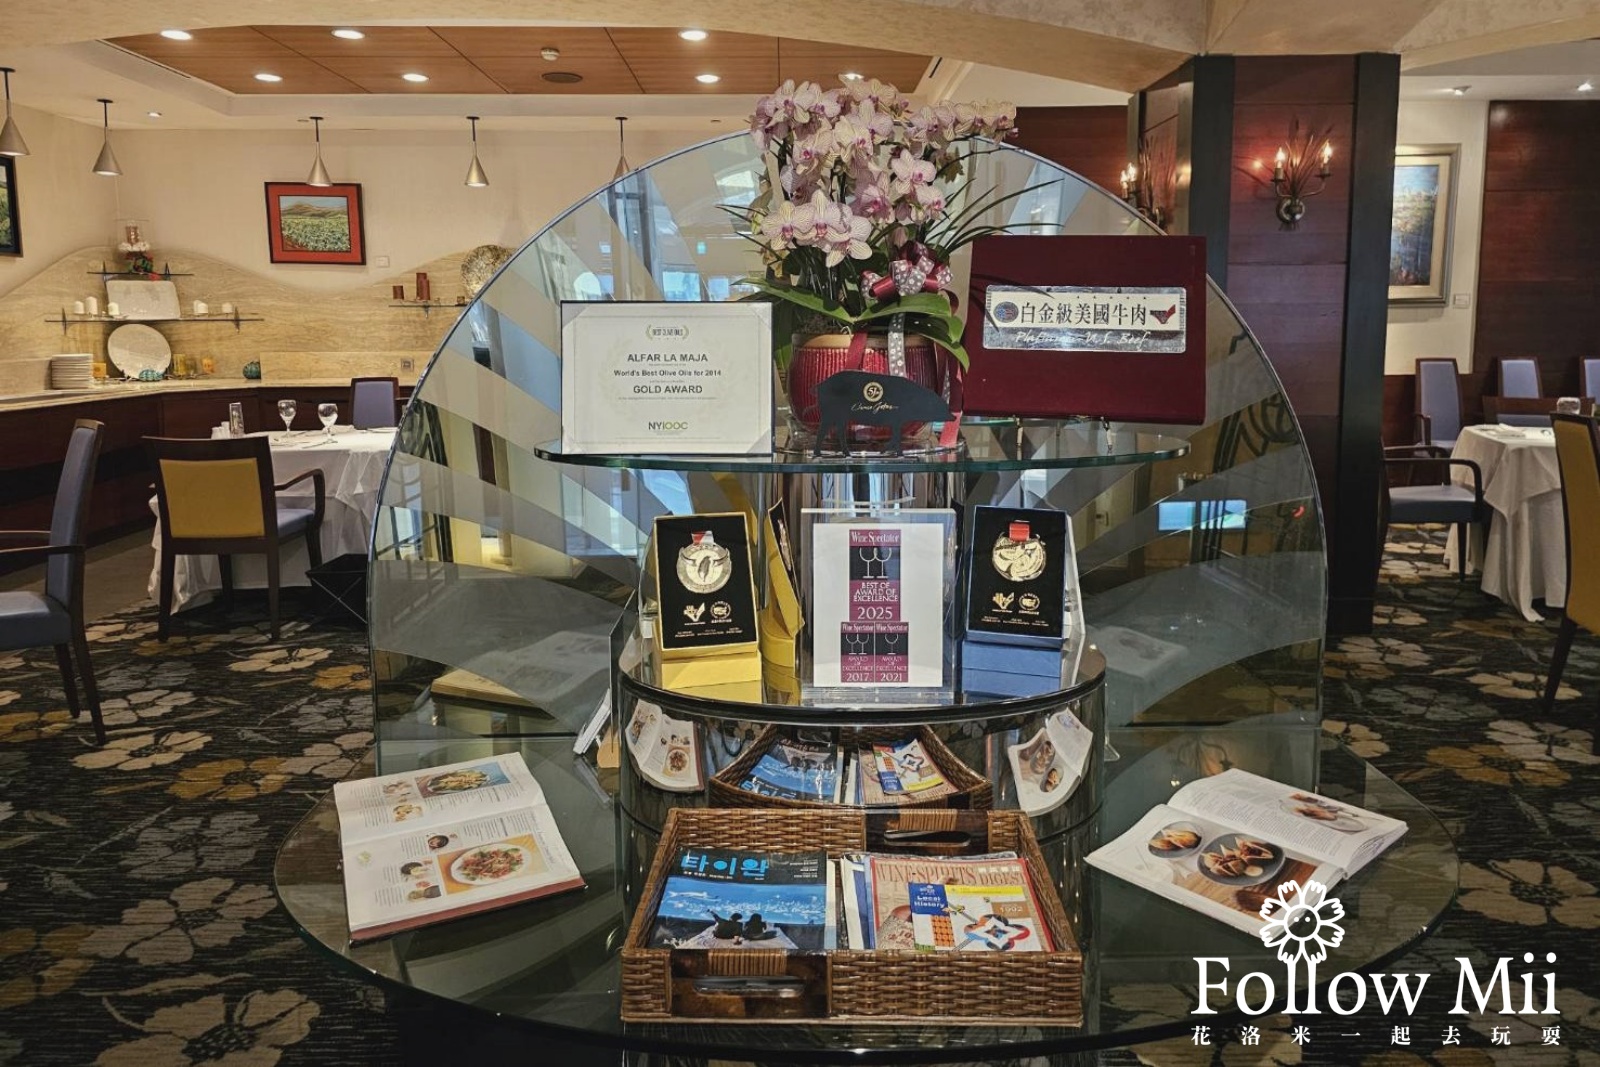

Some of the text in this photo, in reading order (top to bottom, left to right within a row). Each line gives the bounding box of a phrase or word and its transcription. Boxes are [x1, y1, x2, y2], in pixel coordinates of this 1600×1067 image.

[1021, 301, 1146, 326] 白金級美國牛肉
[627, 353, 708, 362] ALFAR LA MAJA
[614, 369, 721, 377] World's Best Olive Oils for 2014
[633, 385, 703, 394] GOLD AWARD
[851, 531, 900, 545] Wine Spectator
[855, 588, 896, 596] AWARD OF
[857, 606, 893, 620] 2025
[846, 672, 870, 682] 2017
[881, 672, 903, 682] 2021
[681, 855, 769, 877] 타이완
